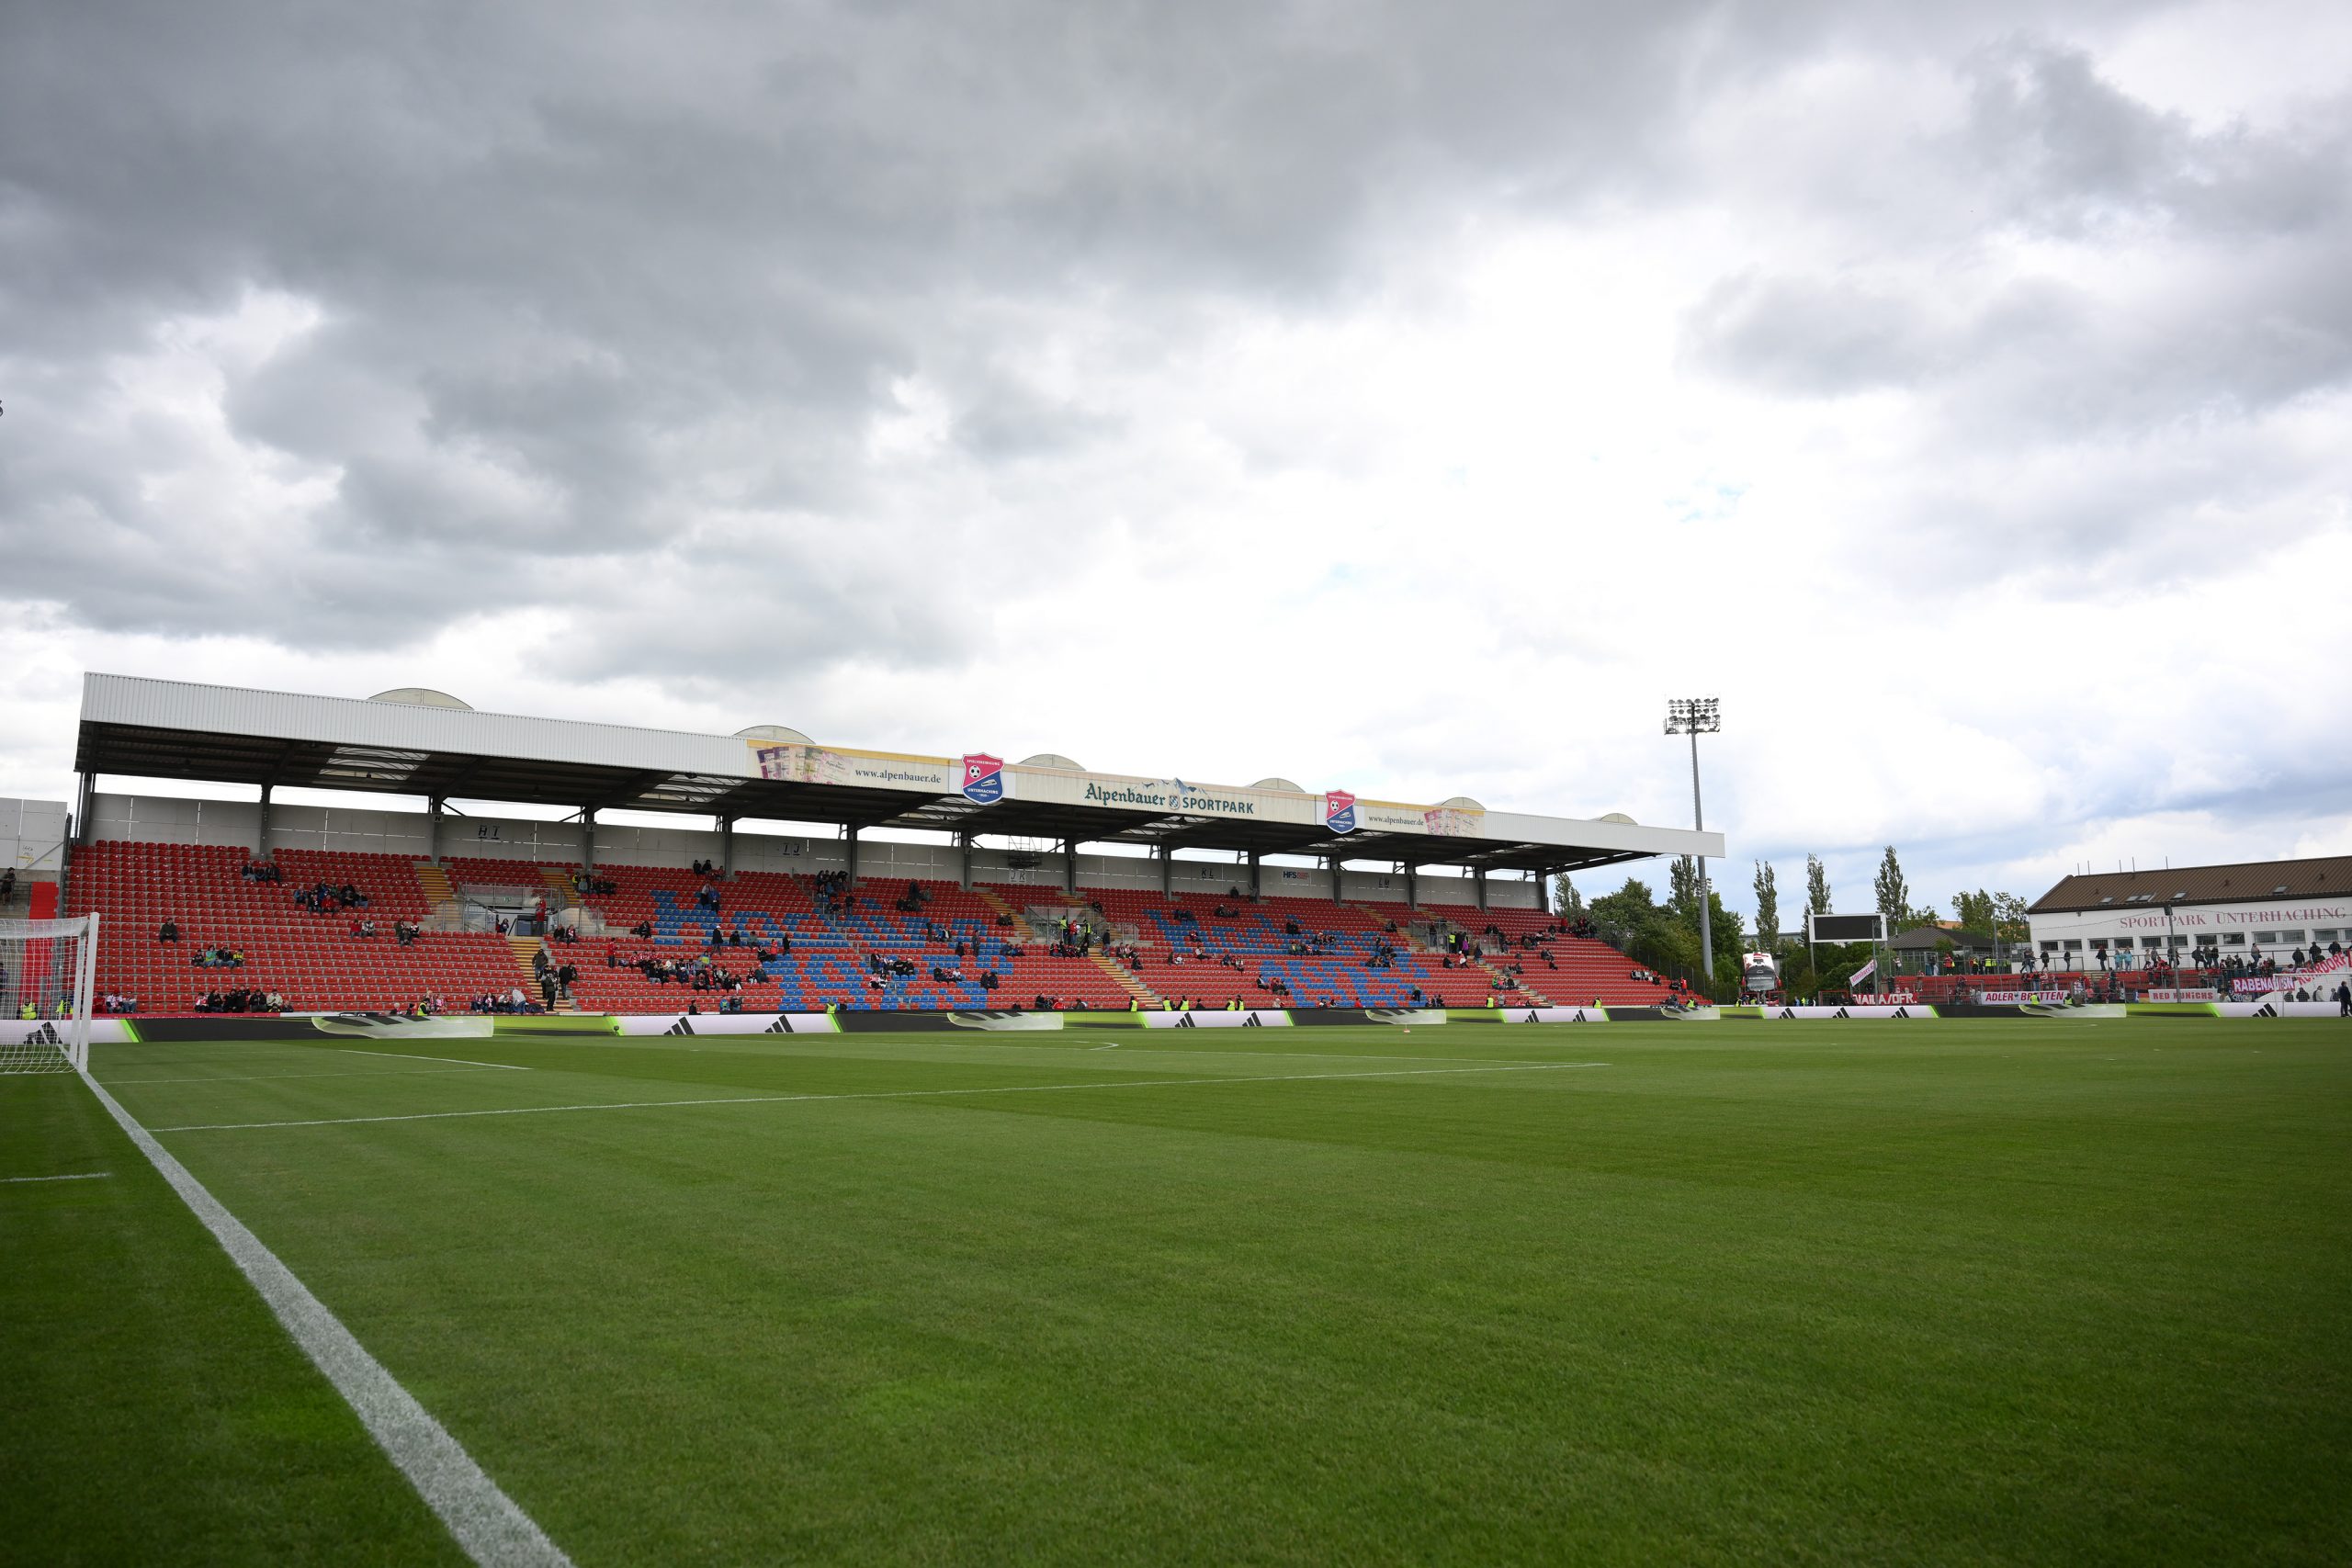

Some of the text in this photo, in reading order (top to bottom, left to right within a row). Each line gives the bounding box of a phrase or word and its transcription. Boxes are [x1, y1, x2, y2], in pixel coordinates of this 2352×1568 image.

[855, 770, 942, 784] www.alpenbauer.de
[1084, 783, 1254, 814] Alpenbauer SPORTPARK
[1368, 815, 1424, 827] www.alpenbauer.de
[1283, 870, 1297, 879] HFS
[2120, 907, 2346, 929] SPORTPARK UNTERHACHING
[1985, 991, 2064, 1001] ADLER BRTTEN
[2153, 992, 2170, 1000] RED
